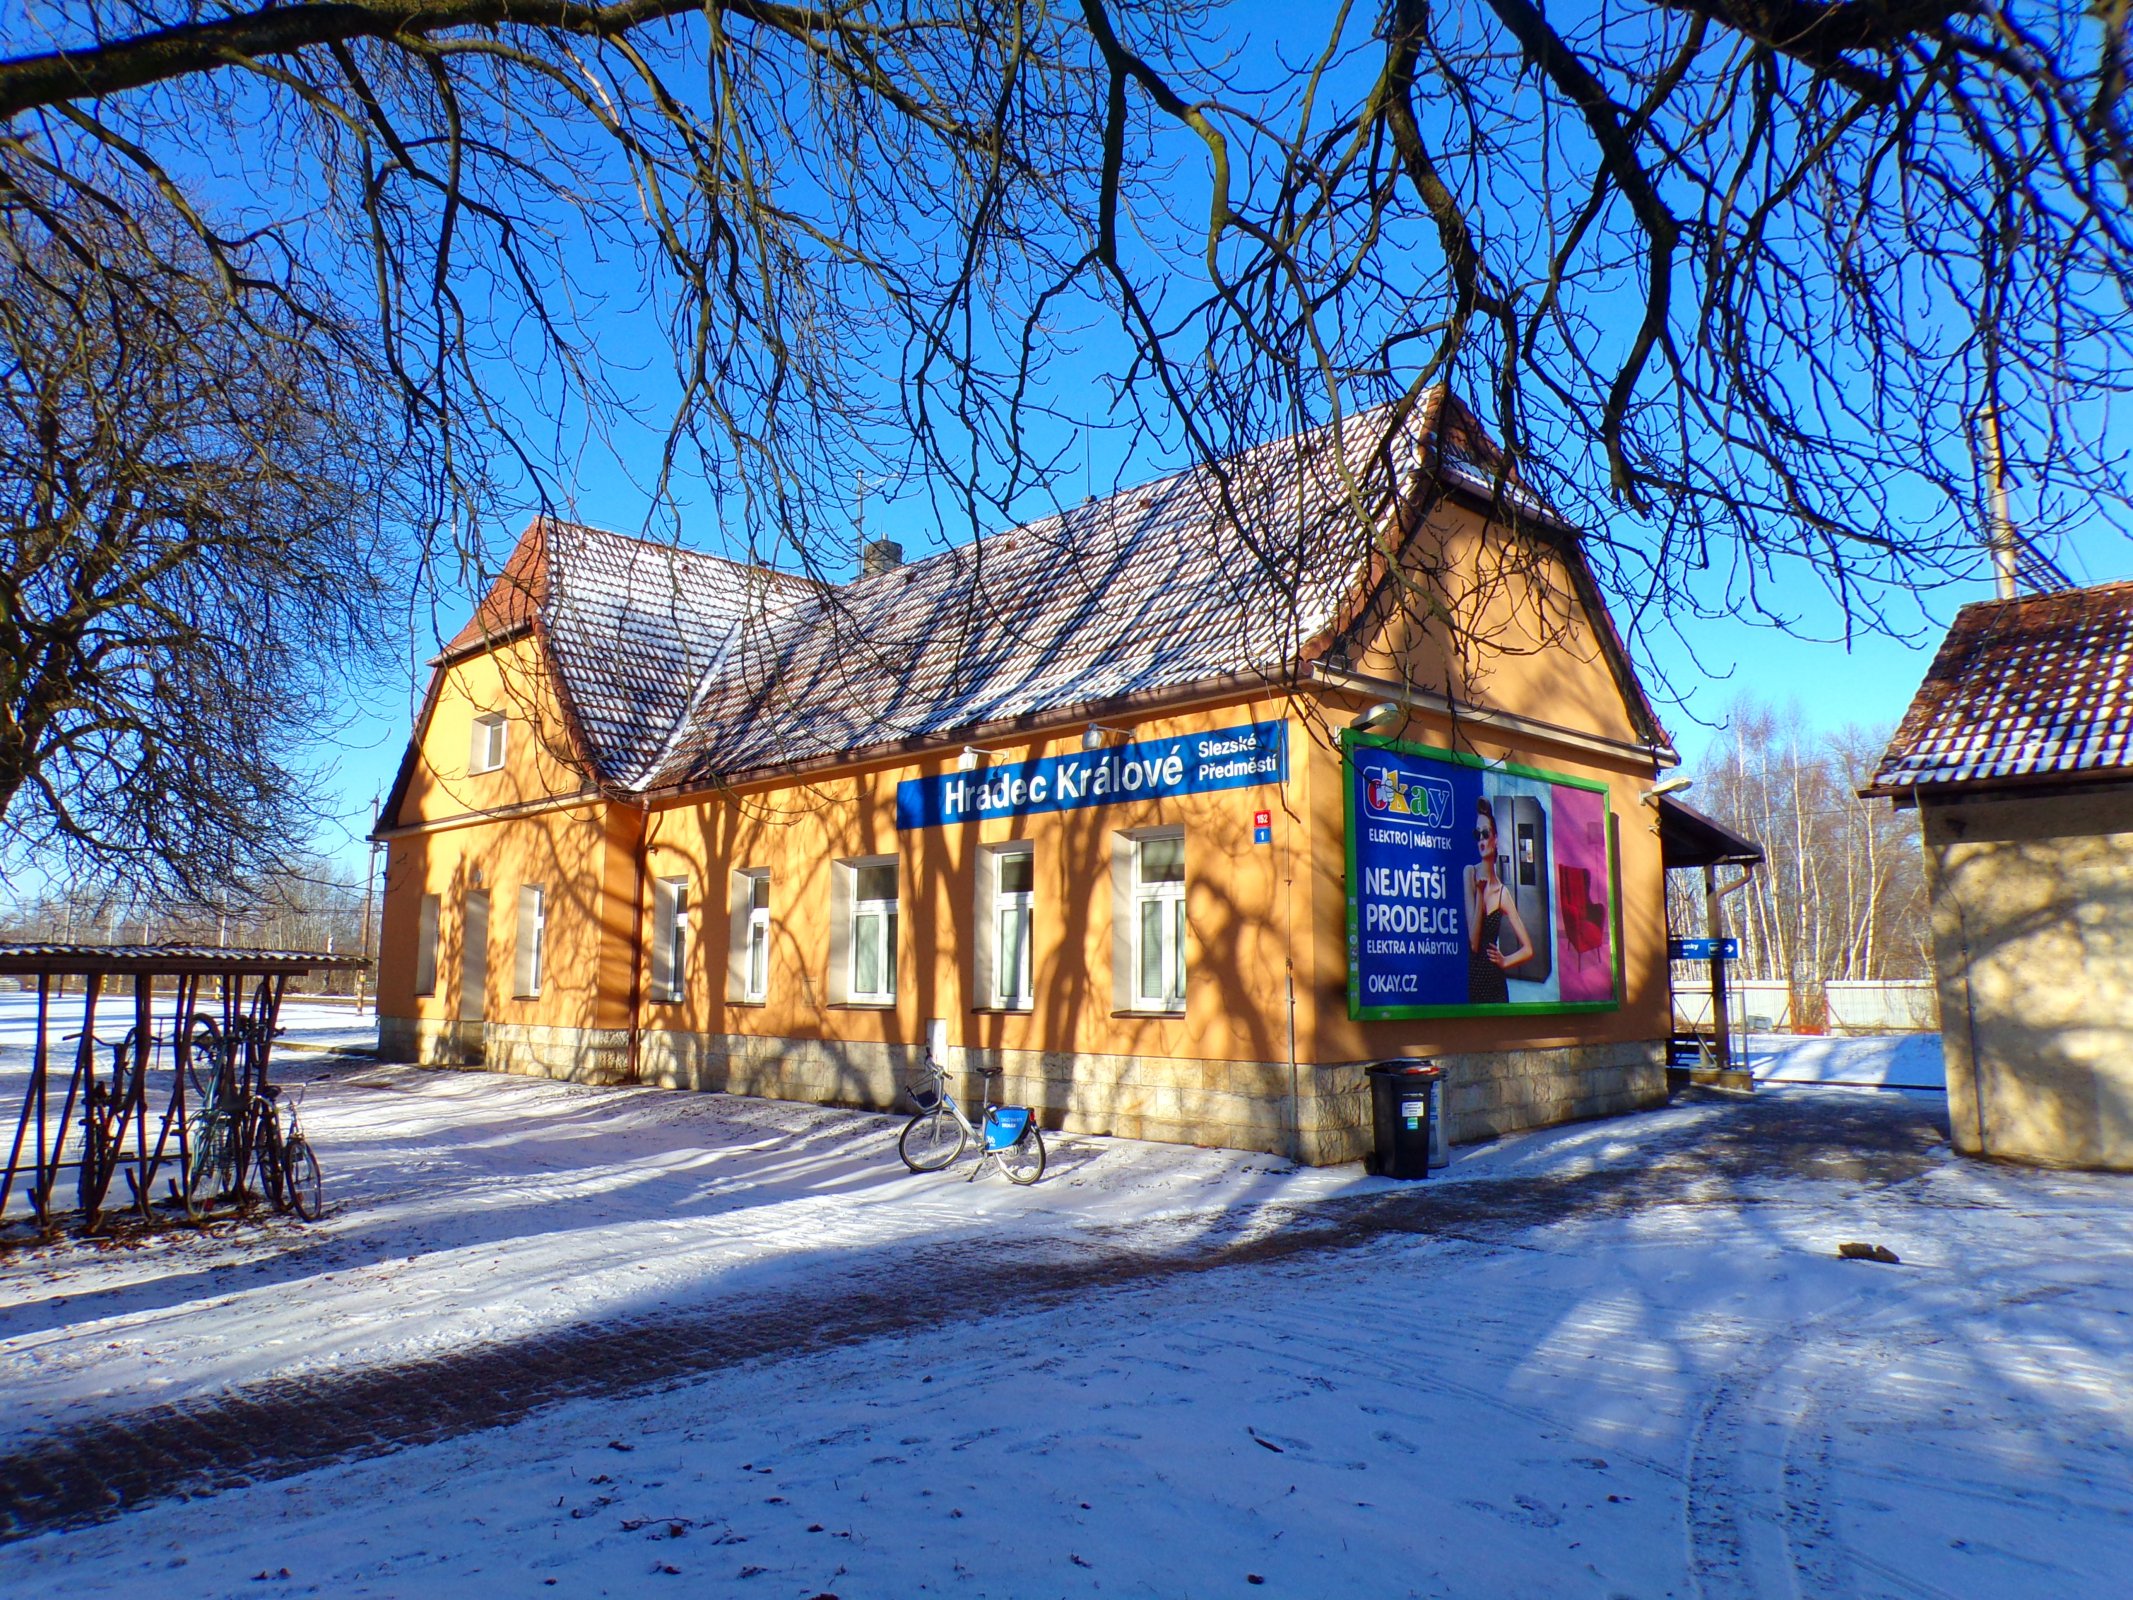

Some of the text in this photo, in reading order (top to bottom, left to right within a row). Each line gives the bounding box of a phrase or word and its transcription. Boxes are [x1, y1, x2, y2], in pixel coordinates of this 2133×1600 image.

[1198, 733, 1257, 758] Slezské
[945, 744, 1184, 815] Hradec Králové
[1198, 753, 1277, 781] Předměstí
[1259, 830, 1266, 841] 1
[1368, 828, 1452, 851] ELEKTRO NÁBYTEK
[1365, 863, 1447, 900] NEJVĚTŠÍ
[1366, 903, 1459, 934] PRODEJCE
[1366, 937, 1459, 956] ELEKTRA A NÁBYTKU
[1368, 974, 1418, 993] OKAY.CZ
